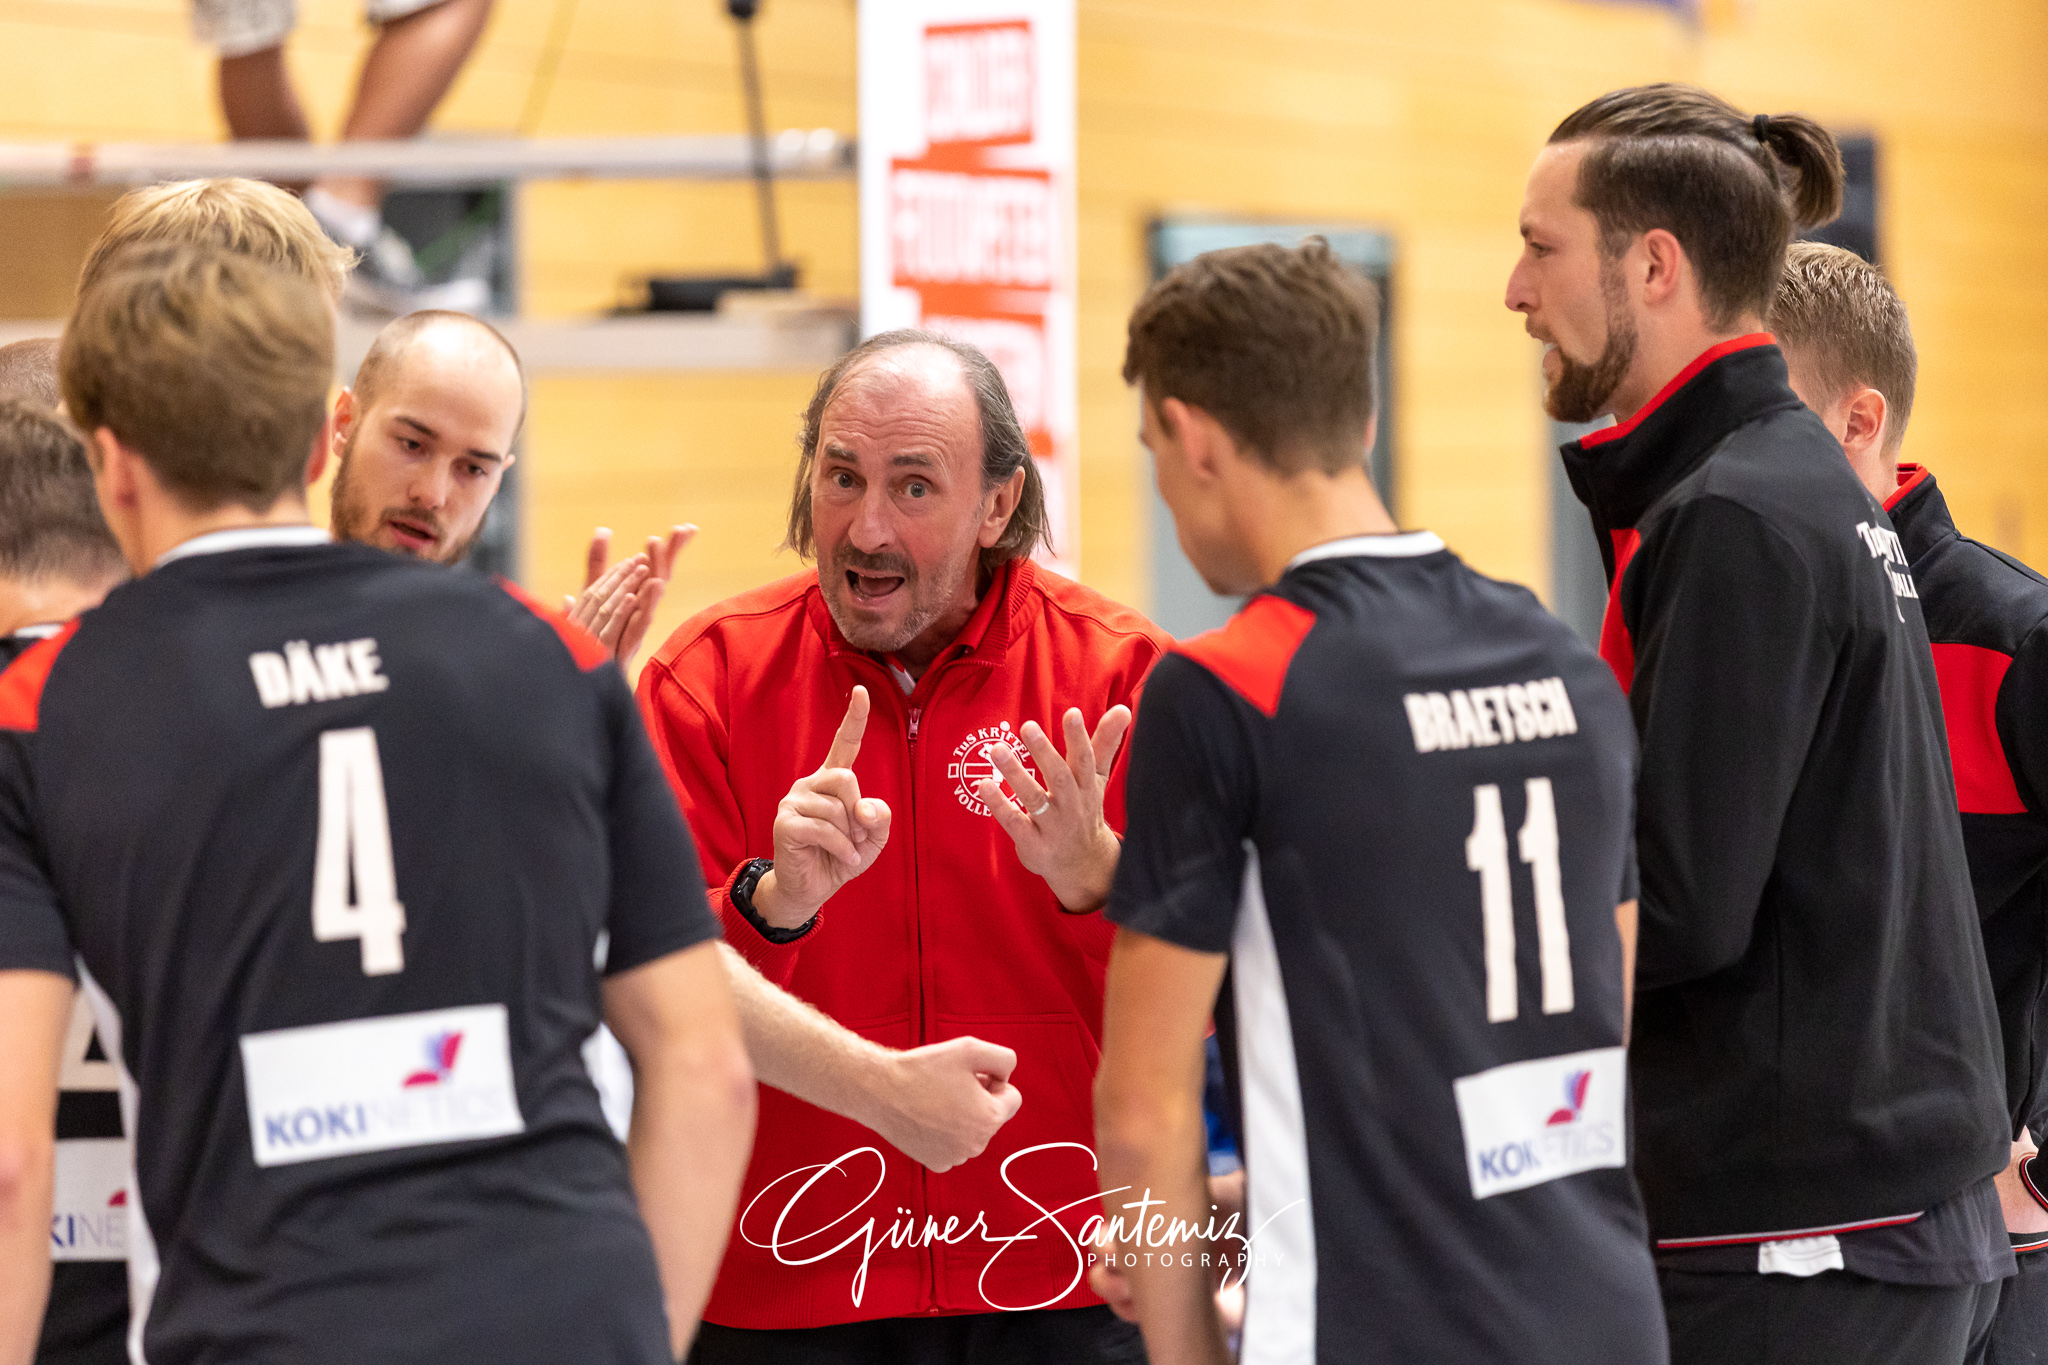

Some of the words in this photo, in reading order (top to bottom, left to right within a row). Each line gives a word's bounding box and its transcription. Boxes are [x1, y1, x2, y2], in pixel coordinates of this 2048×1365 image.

[249, 638, 389, 708] DÄKE
[1404, 677, 1578, 754] BRAETSCH
[953, 784, 992, 817] VOLLE
[312, 727, 405, 976] 4
[1466, 777, 1573, 1024] 11
